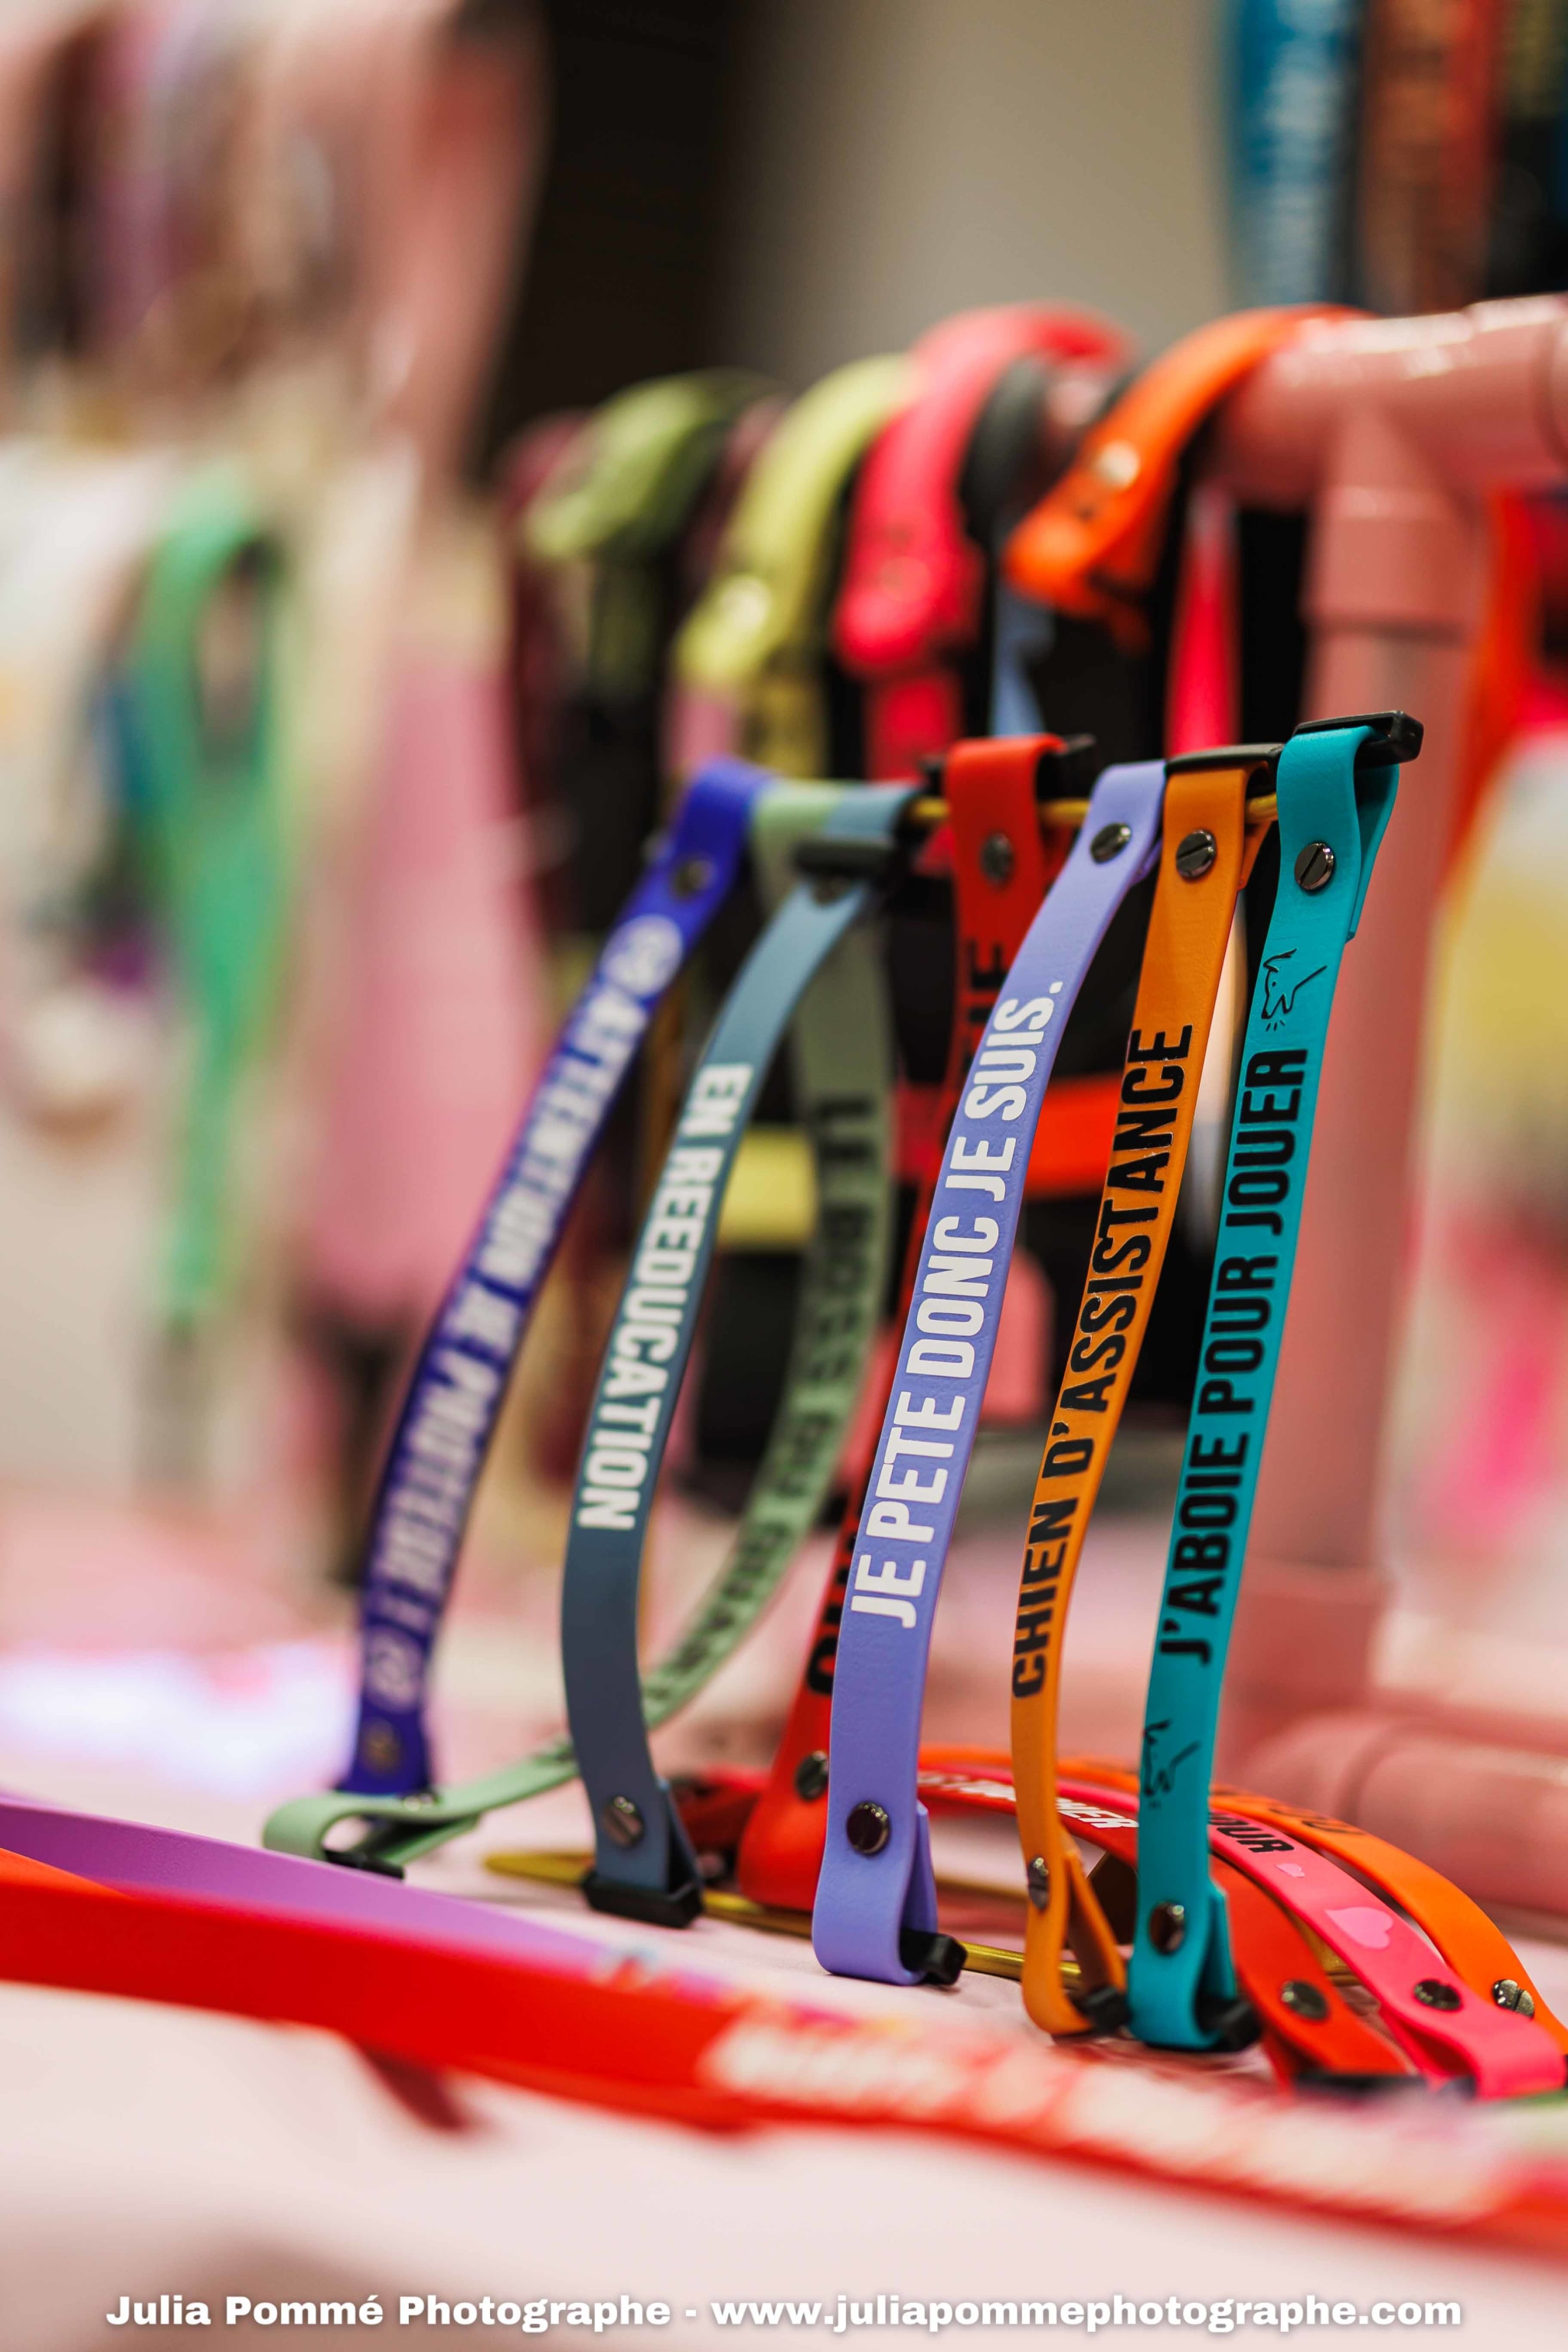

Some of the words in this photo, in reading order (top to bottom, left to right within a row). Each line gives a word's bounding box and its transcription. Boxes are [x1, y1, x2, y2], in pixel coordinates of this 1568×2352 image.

[684, 1063, 752, 1137] EN
[965, 981, 1064, 1121] SUIS.
[949, 1137, 1017, 1202] JE
[1226, 1048, 1308, 1236] JOUER
[906, 1215, 999, 1379] DONC
[1040, 1024, 1193, 1479] D'ASSISTANCE
[580, 1146, 724, 1530] REEDUCATION
[1196, 1255, 1279, 1416] POUR
[866, 1390, 966, 1543] PETE
[851, 1553, 926, 1628] JE
[1011, 1498, 1078, 1699] CHIEN
[1158, 1432, 1250, 1666] J'ABOIE
